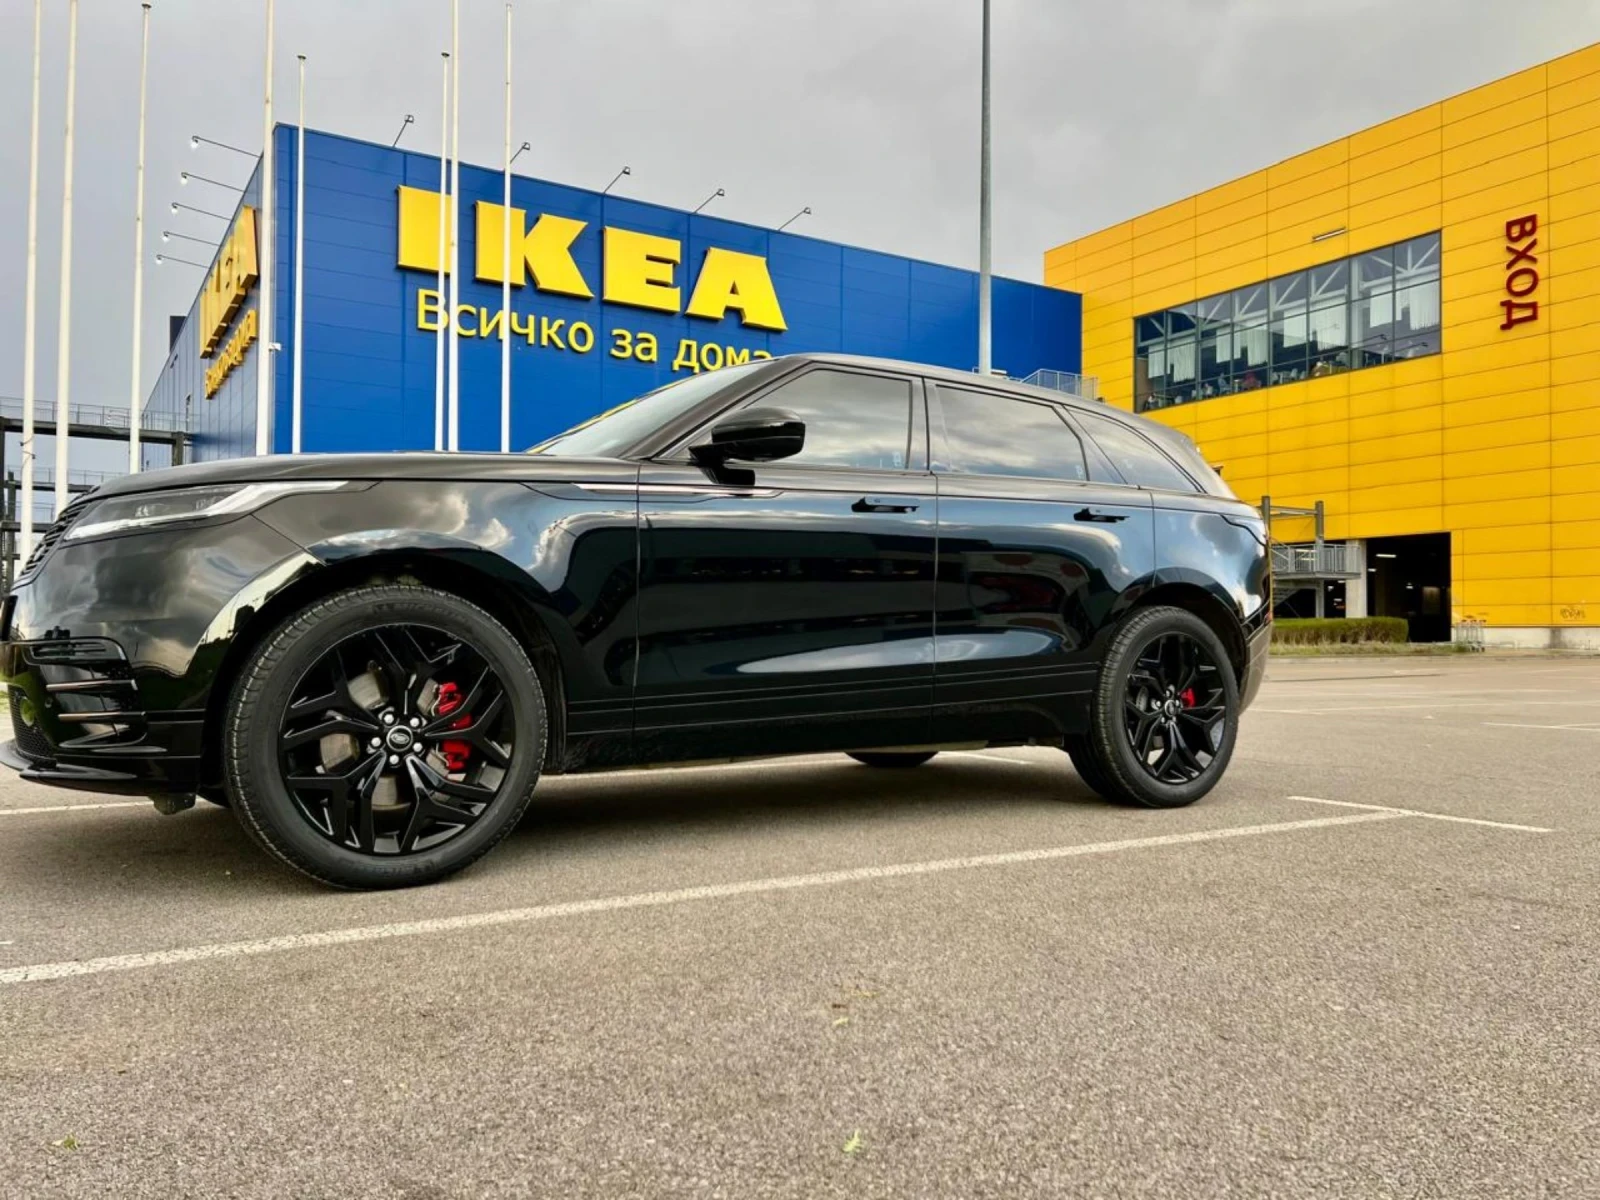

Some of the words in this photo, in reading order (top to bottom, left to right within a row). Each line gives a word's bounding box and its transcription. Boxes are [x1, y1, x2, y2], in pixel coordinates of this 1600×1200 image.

[397, 184, 788, 331] IKEA
[1500, 213, 1539, 331] ВХОД
[416, 287, 595, 354] Всичко
[610, 328, 658, 362] за
